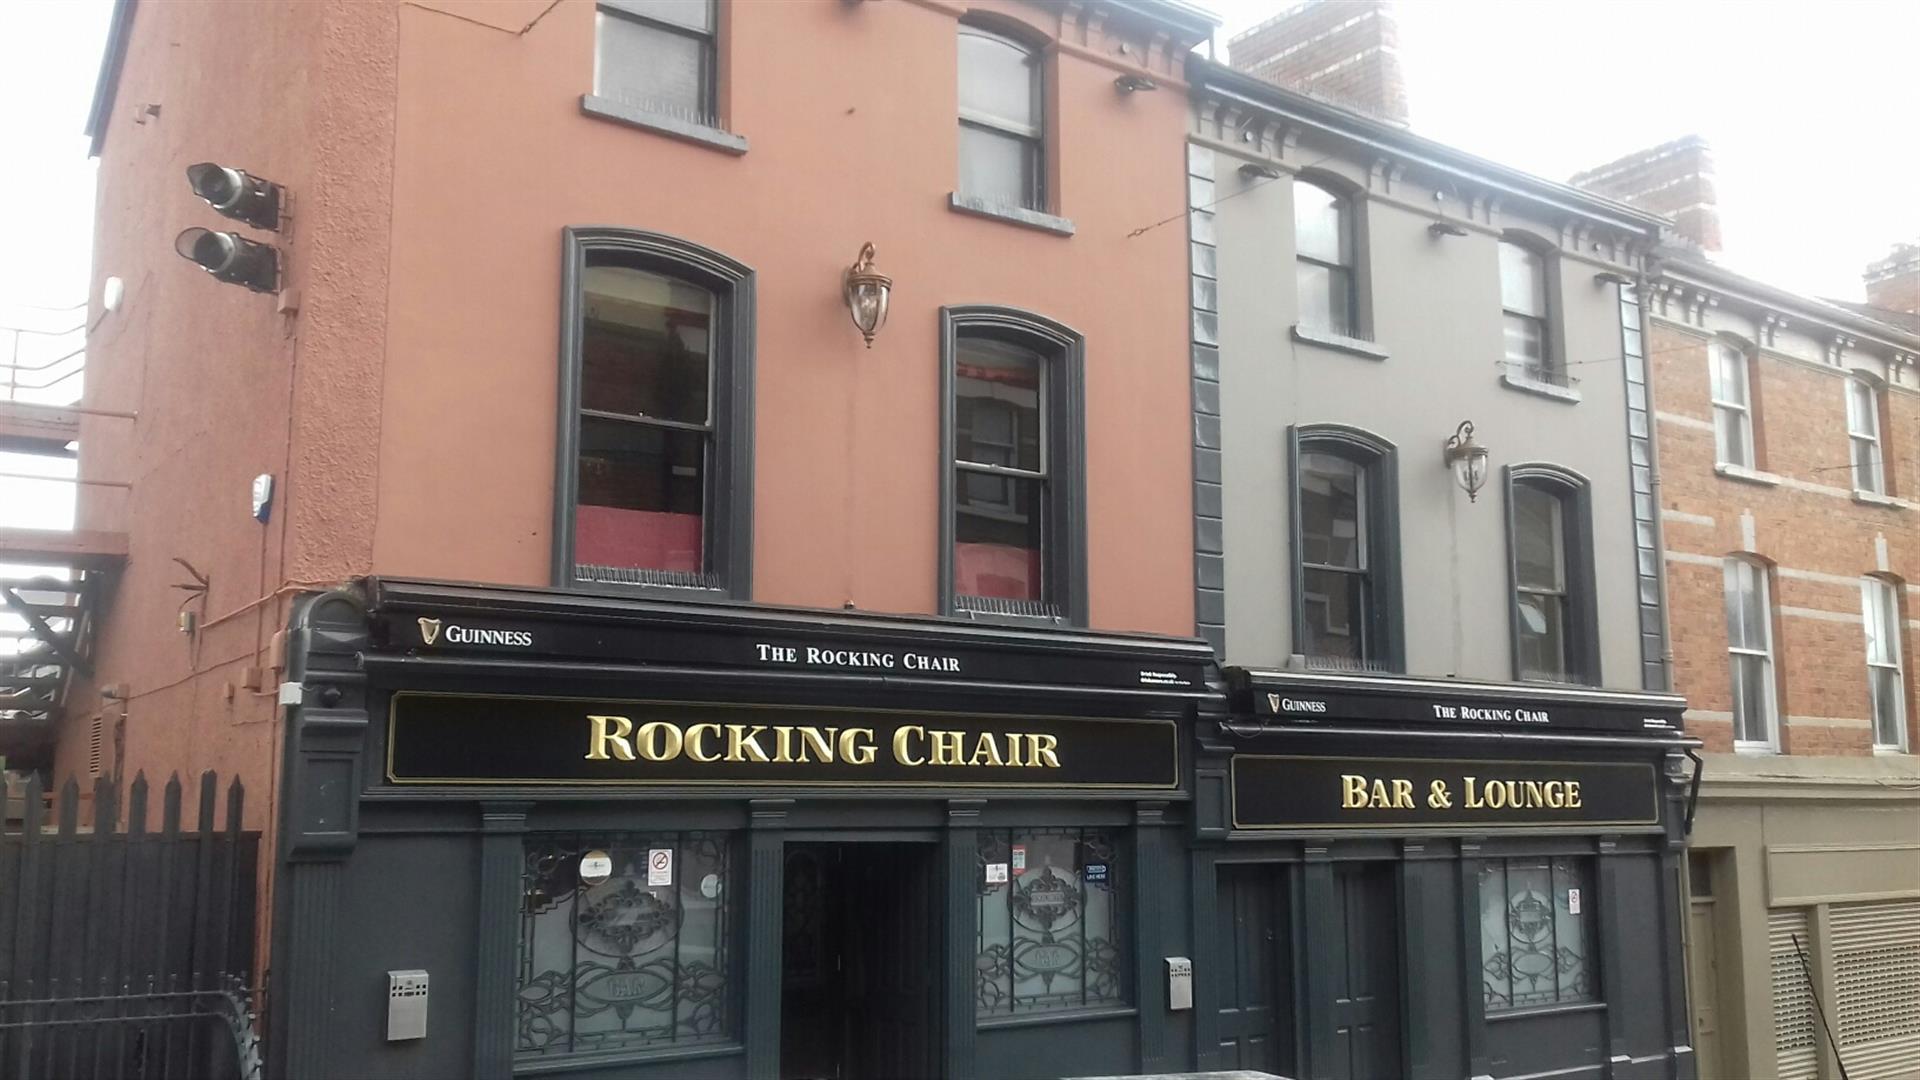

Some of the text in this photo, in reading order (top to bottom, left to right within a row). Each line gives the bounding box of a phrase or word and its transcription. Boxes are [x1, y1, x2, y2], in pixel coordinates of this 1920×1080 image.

[445, 625, 534, 648] GUINNESS
[755, 643, 961, 673] THE ROCKING CHAIR
[1281, 698, 1327, 714] GUINNESS
[1432, 704, 1550, 723] THE ROCKING CHAIR
[585, 714, 1061, 769] ROCKING CHAIR
[1340, 773, 1583, 809] BAR & LOUNGE
